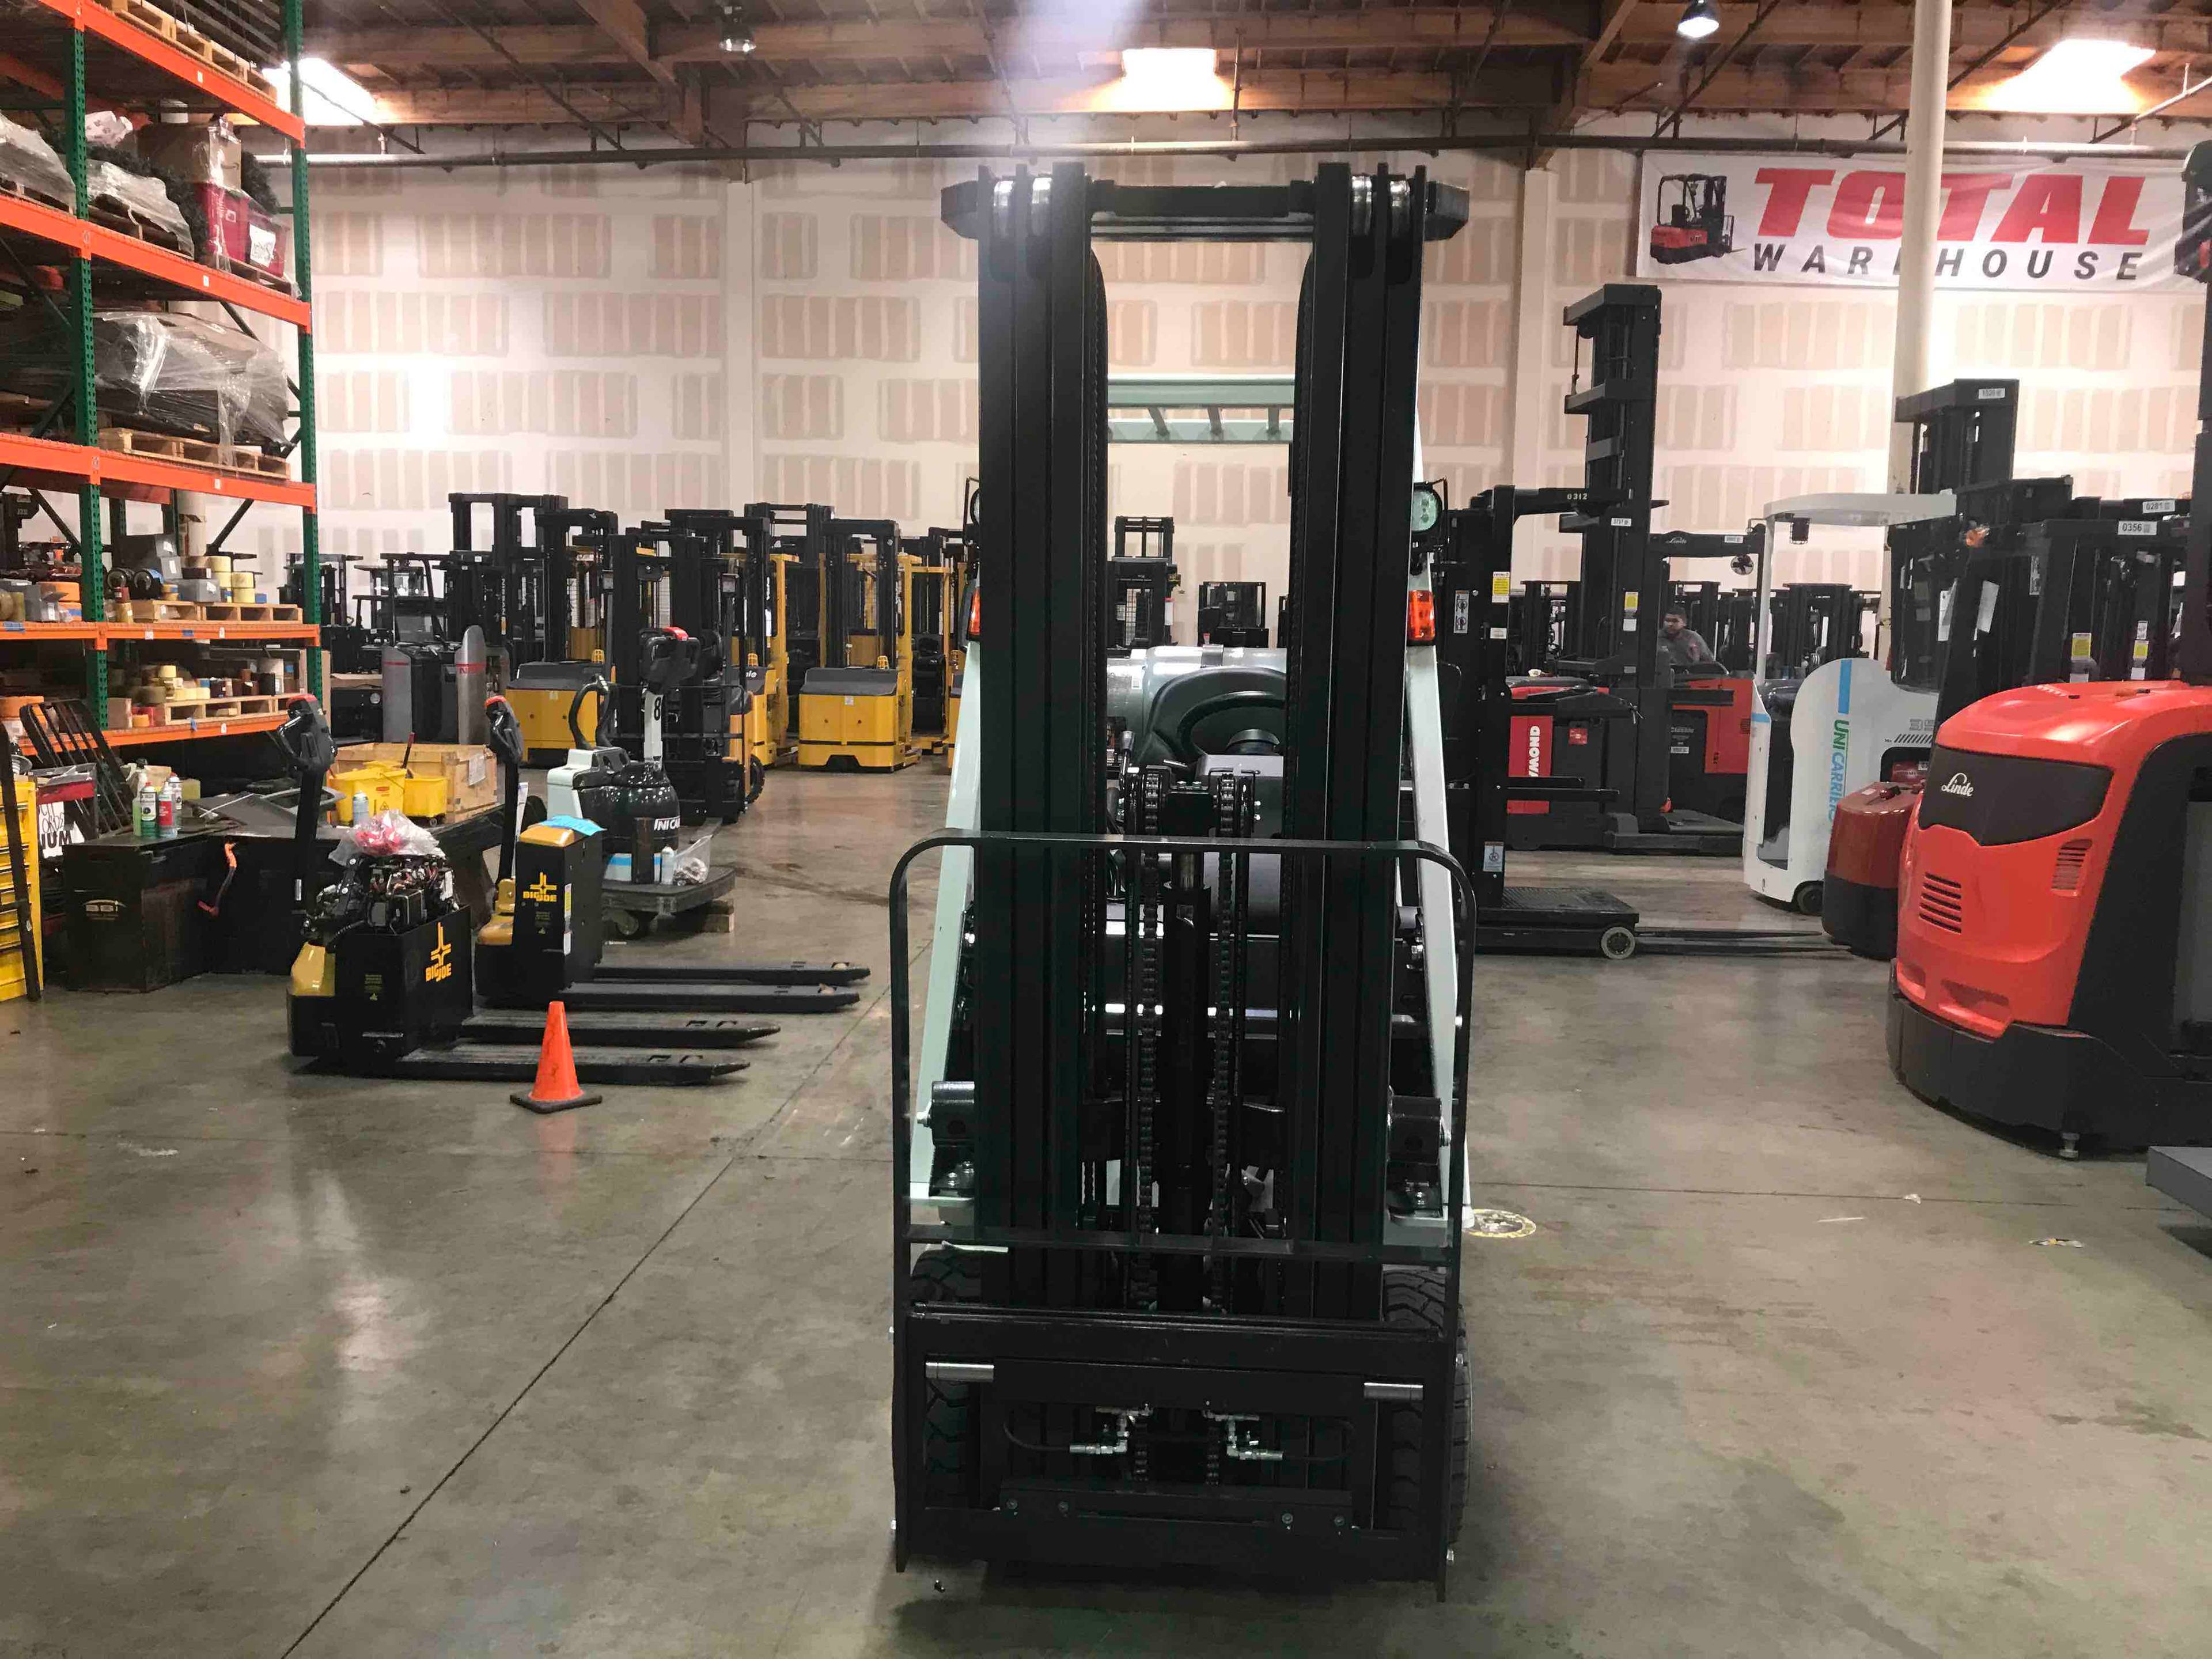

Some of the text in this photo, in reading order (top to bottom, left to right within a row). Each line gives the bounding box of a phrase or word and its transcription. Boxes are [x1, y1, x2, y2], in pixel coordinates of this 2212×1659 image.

[1754, 167, 2150, 245] TOTAL
[2122, 522, 2142, 532] 0356
[653, 696, 662, 721] 8
[1941, 772, 1974, 797] Linde
